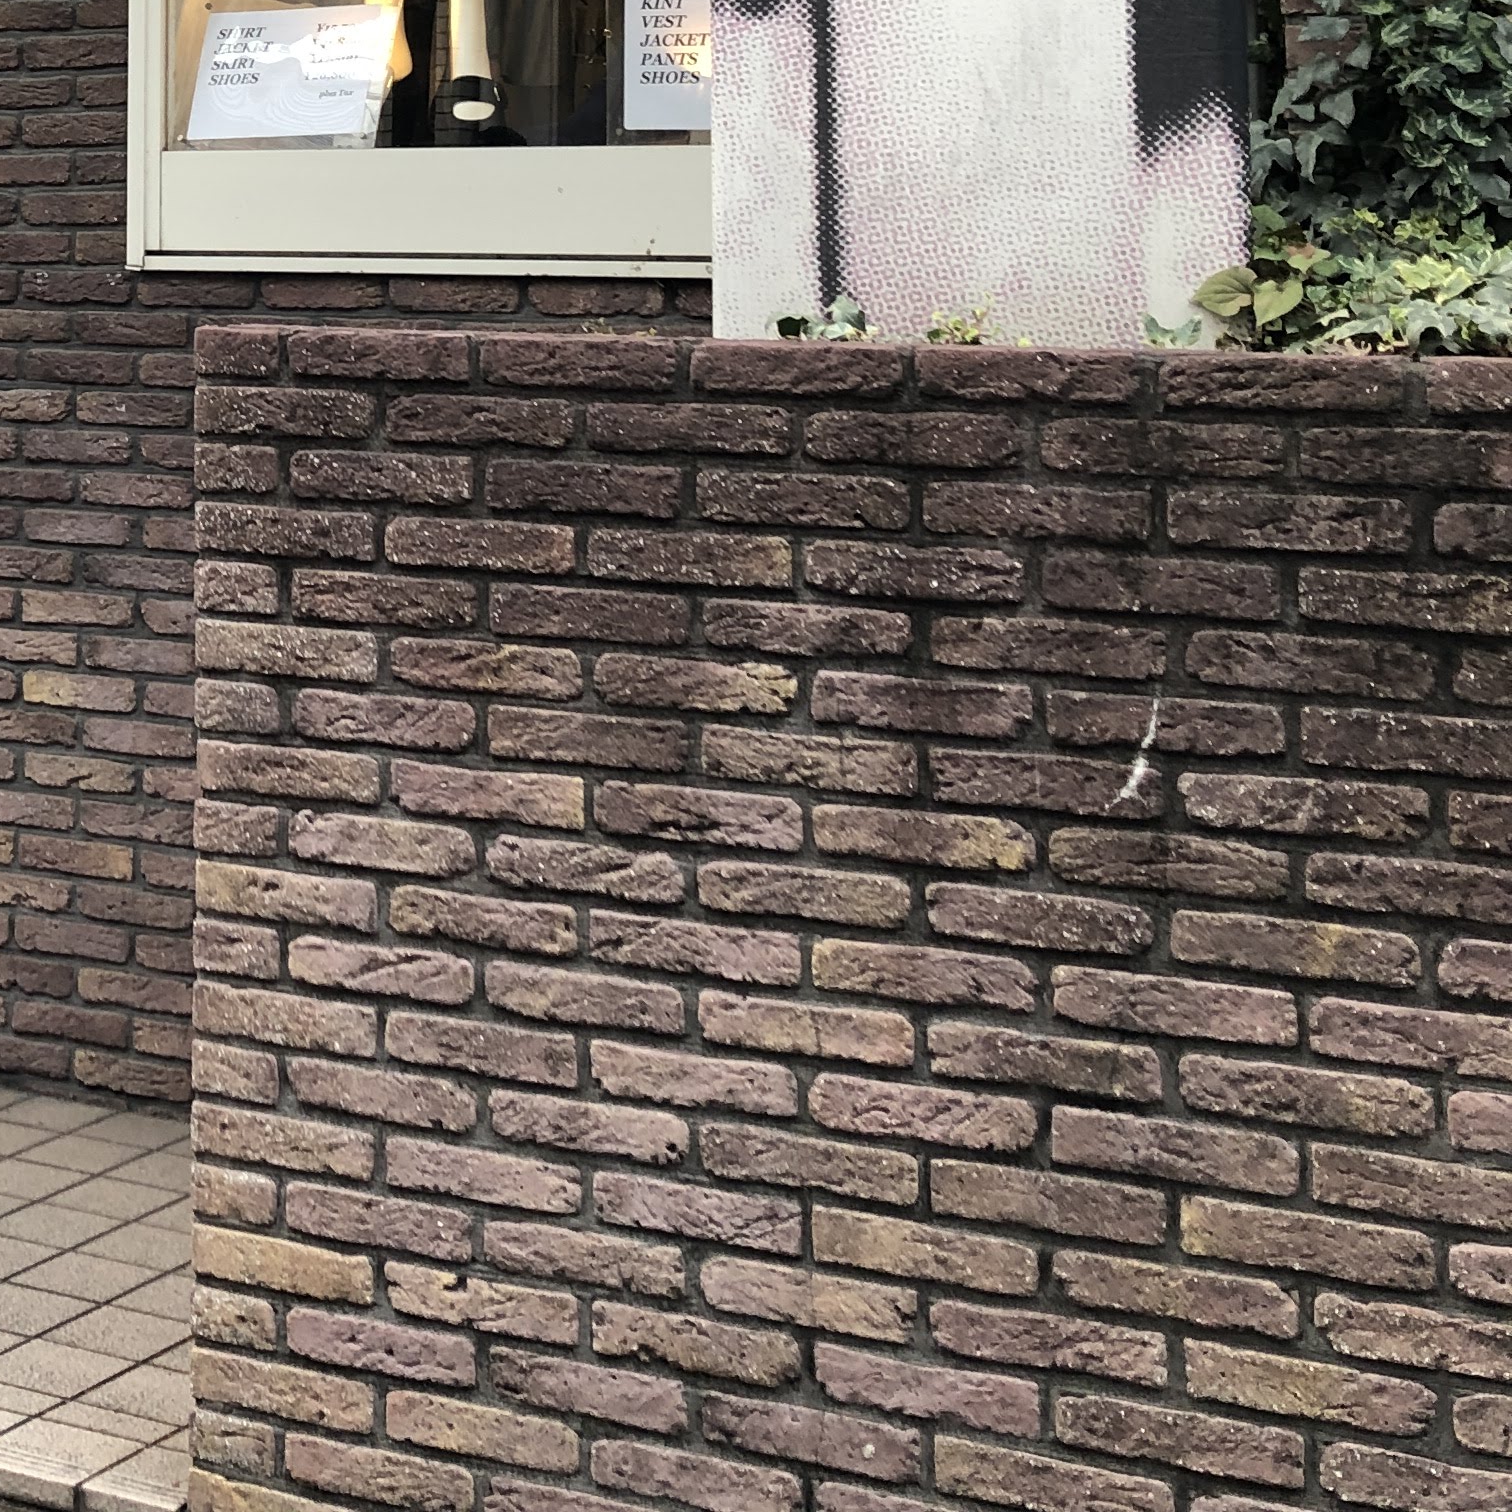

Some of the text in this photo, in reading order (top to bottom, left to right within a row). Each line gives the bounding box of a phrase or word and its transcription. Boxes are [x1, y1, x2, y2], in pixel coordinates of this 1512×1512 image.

[640, 14, 688, 29] VEST
[639, 32, 711, 48] JACKET
[640, 51, 699, 66] PANTS
[207, 72, 260, 87] SHOES
[639, 70, 701, 85] SHOES
